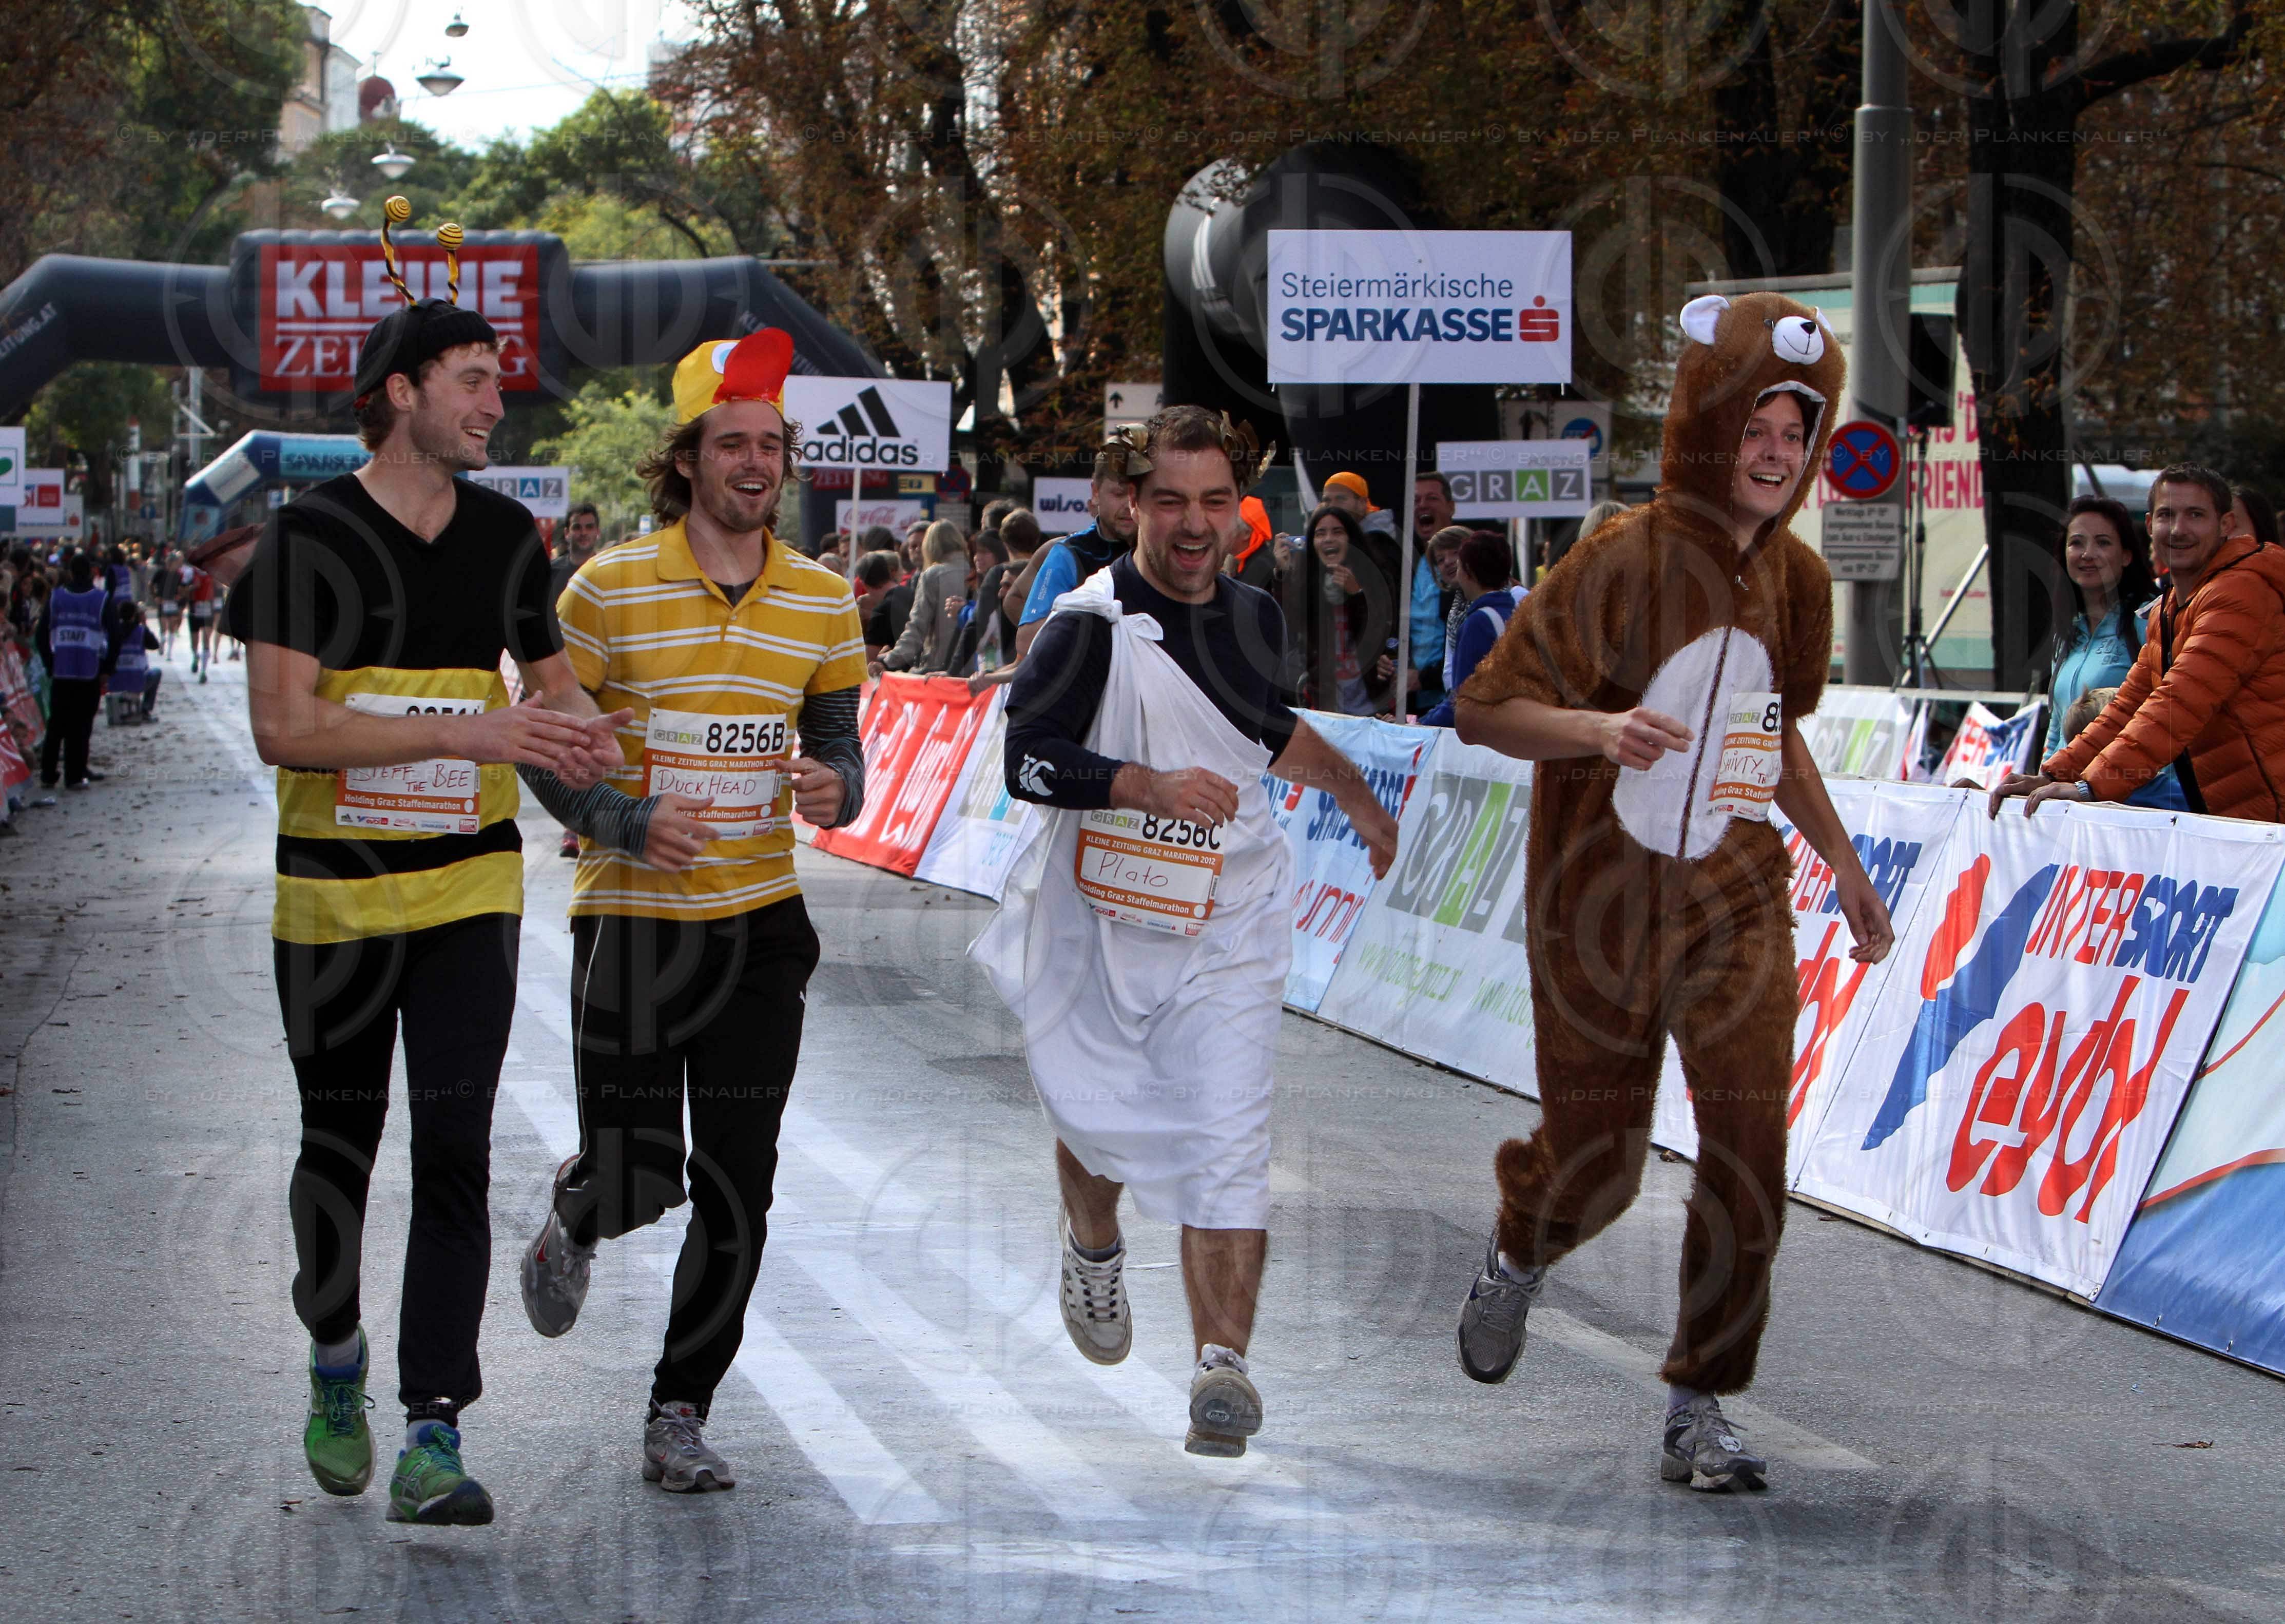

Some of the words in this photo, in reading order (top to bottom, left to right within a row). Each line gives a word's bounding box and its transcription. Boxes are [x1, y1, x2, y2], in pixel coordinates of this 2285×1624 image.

[277, 260, 524, 318] KLEINE
[1282, 272, 1513, 298] Steiermärkische
[1281, 307, 1513, 342] SPARKASSE
[804, 435, 918, 465] adidas
[1447, 470, 1581, 500] GRAZ
[59, 630, 86, 641] STAFF
[655, 730, 703, 745] GRAZ
[706, 722, 785, 753] 8256B
[433, 763, 471, 788] BEE
[652, 755, 676, 764] KLEINE
[677, 758, 707, 767] ZEITUNG
[729, 760, 764, 768] MARATHON
[344, 794, 375, 807] Holding
[377, 798, 396, 807] Graz
[398, 799, 461, 811] Staffelmarathon
[1091, 812, 1139, 829] GRAZ
[1086, 835, 1110, 846] KLEINE
[1111, 839, 1141, 853] ZEITUNG
[1142, 846, 1160, 857] GRAZ
[1163, 850, 1199, 863] MARATHON
[1200, 856, 1216, 865] 2012
[1403, 792, 1524, 917] GRAZ
[1098, 852, 1168, 887] Plato
[1079, 881, 1106, 898] Holding
[1107, 891, 1125, 902] Graz
[1127, 895, 1190, 914] Staffelmarathon
[2026, 864, 2239, 983] INTERSPORT
